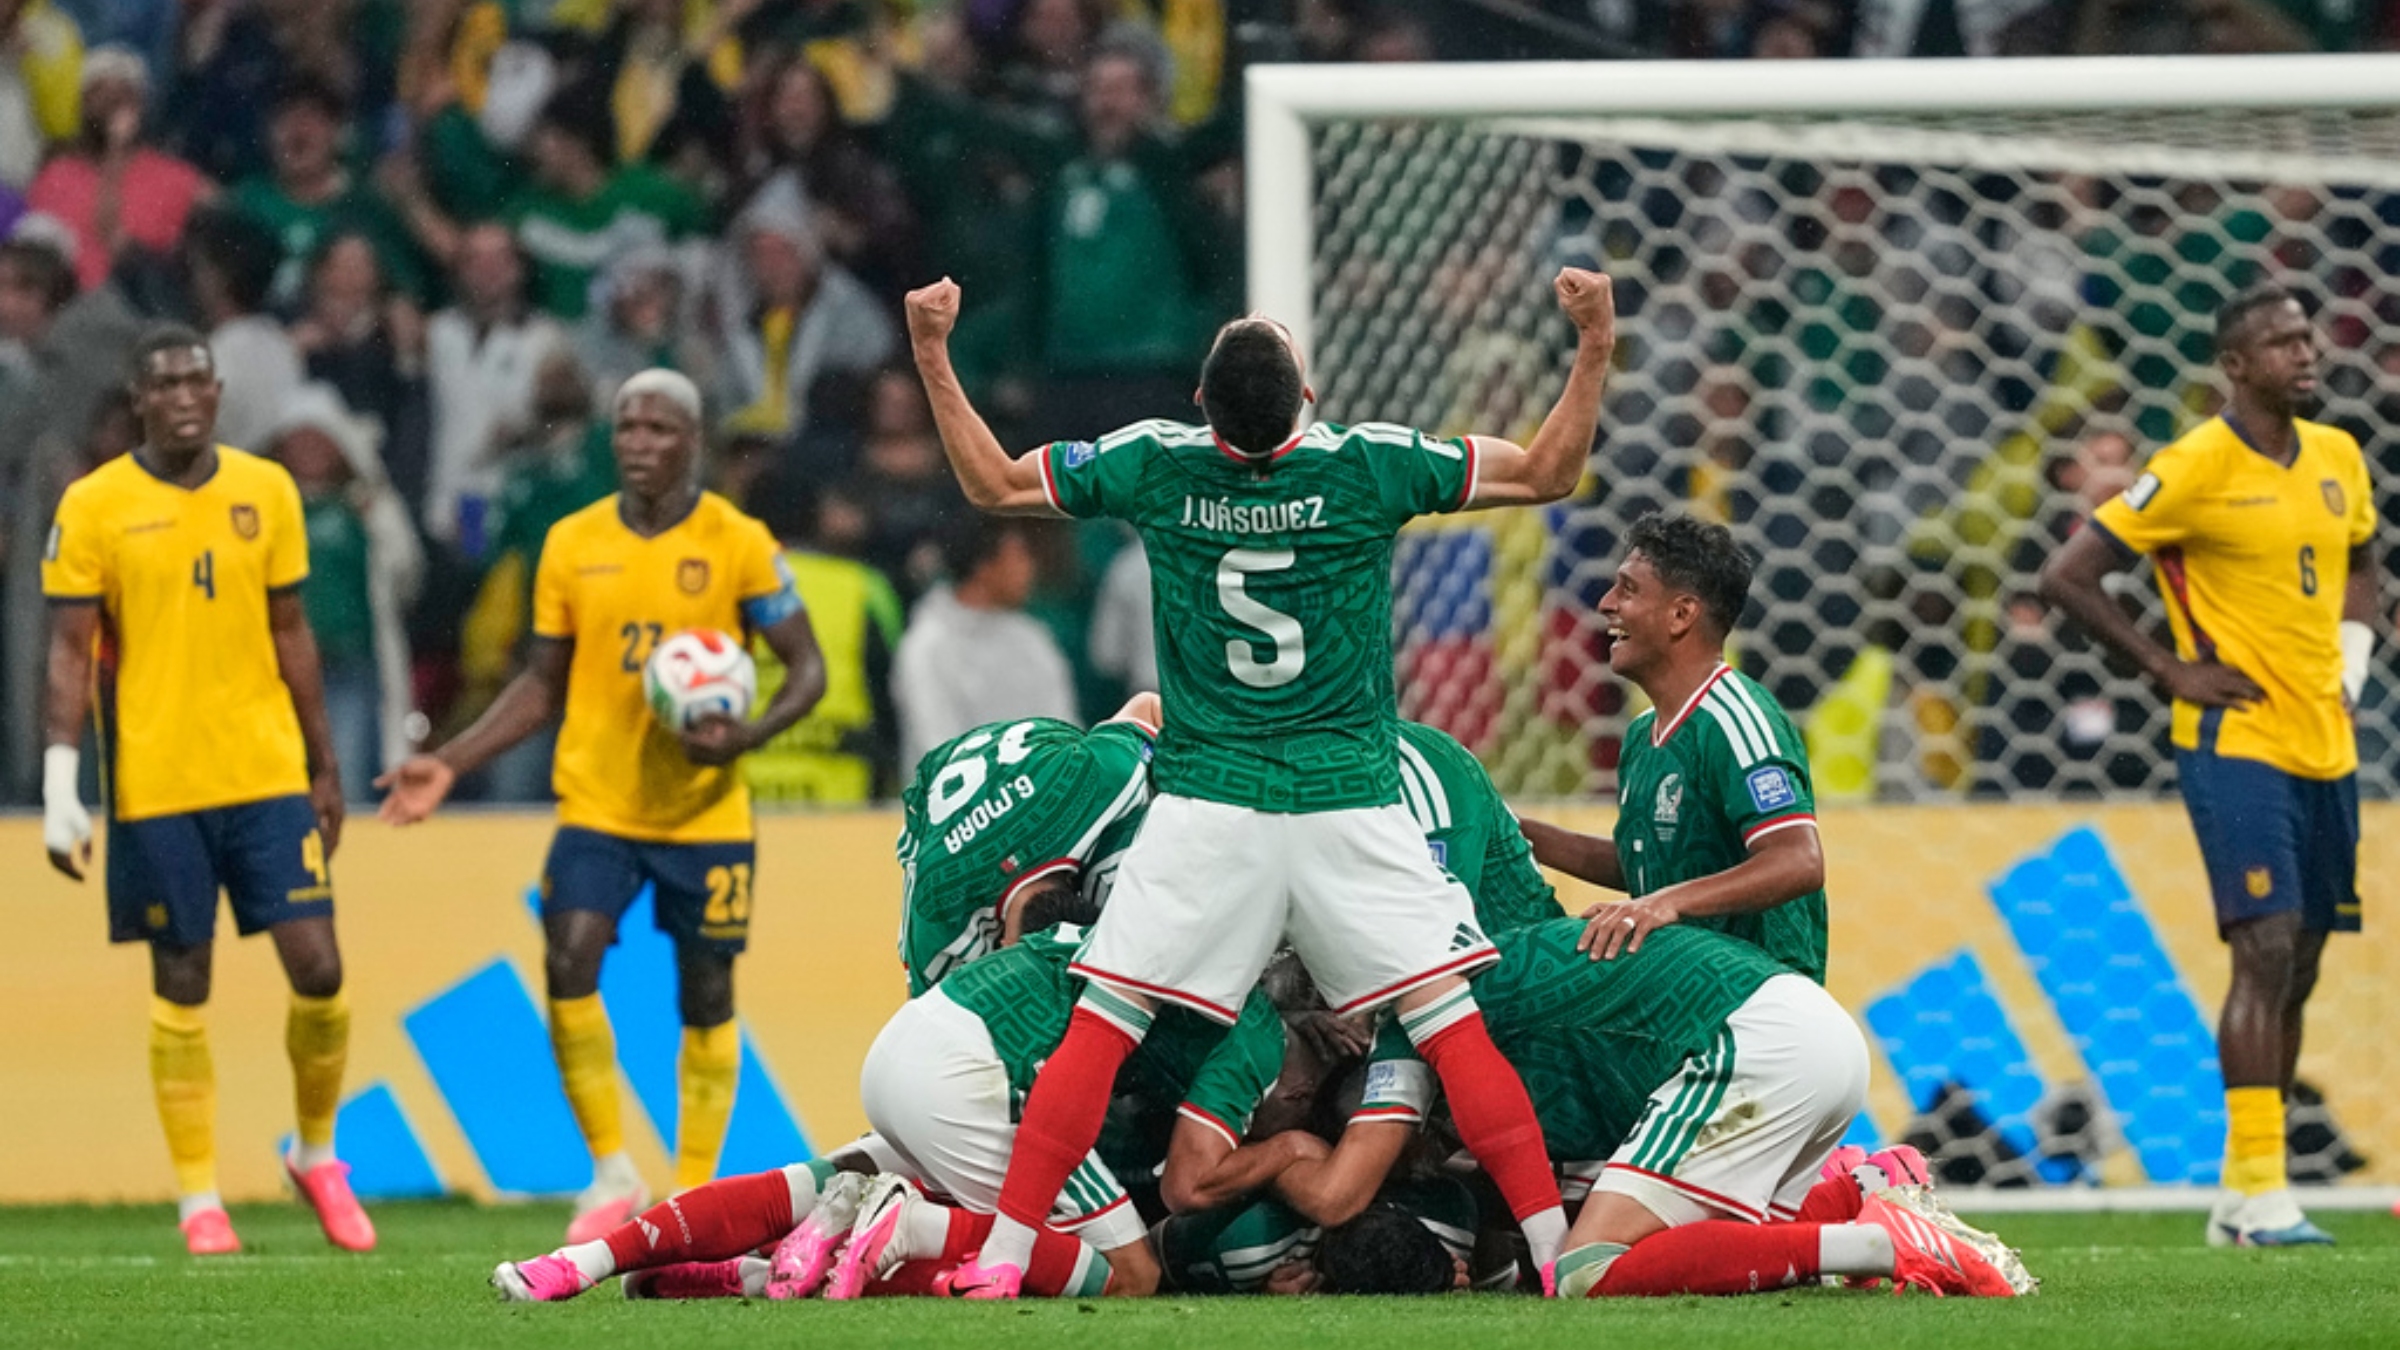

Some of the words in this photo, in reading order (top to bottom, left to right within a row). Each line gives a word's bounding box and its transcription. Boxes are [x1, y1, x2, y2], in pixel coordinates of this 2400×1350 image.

[1181, 495, 1328, 533] J.VÁSQUEZ
[193, 549, 215, 600] 4
[2298, 544, 2318, 596] 6
[1217, 548, 1306, 688] 5
[943, 774, 1036, 855] G.MORA
[302, 828, 326, 882] 4
[704, 863, 751, 922] 23
